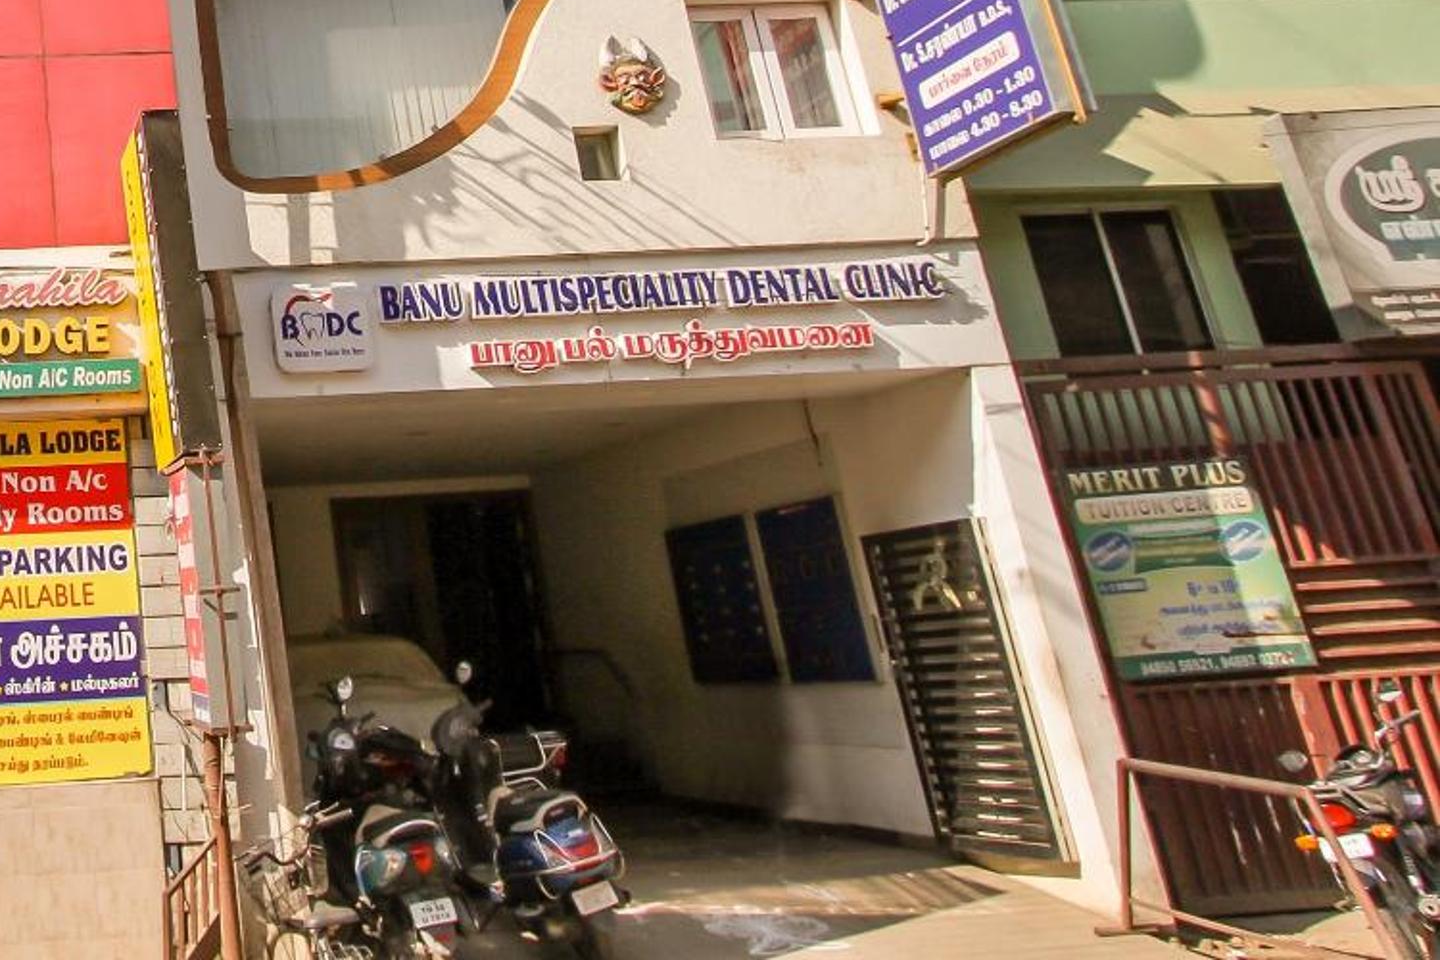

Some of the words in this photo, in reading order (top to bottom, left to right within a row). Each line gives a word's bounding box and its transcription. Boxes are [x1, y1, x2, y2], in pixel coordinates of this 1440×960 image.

[379, 282, 462, 321] BANU
[472, 269, 717, 318] MULTISPECIALITY
[727, 266, 839, 306] DENTAL
[844, 261, 943, 299] CLINIC
[469, 340, 559, 372] பானு
[563, 326, 616, 360] பல்
[623, 319, 874, 365] மருத்துவமனை
[73, 365, 132, 387] Rooms
[40, 429, 122, 455] LODGE
[2, 471, 56, 494] Non
[66, 468, 109, 492] A/c
[1068, 467, 1161, 495] MERIT
[1170, 460, 1246, 488] PLUS
[28, 502, 124, 525] Rooms
[1088, 497, 1165, 520] TUITION
[11, 621, 138, 669] அச்சகம்
